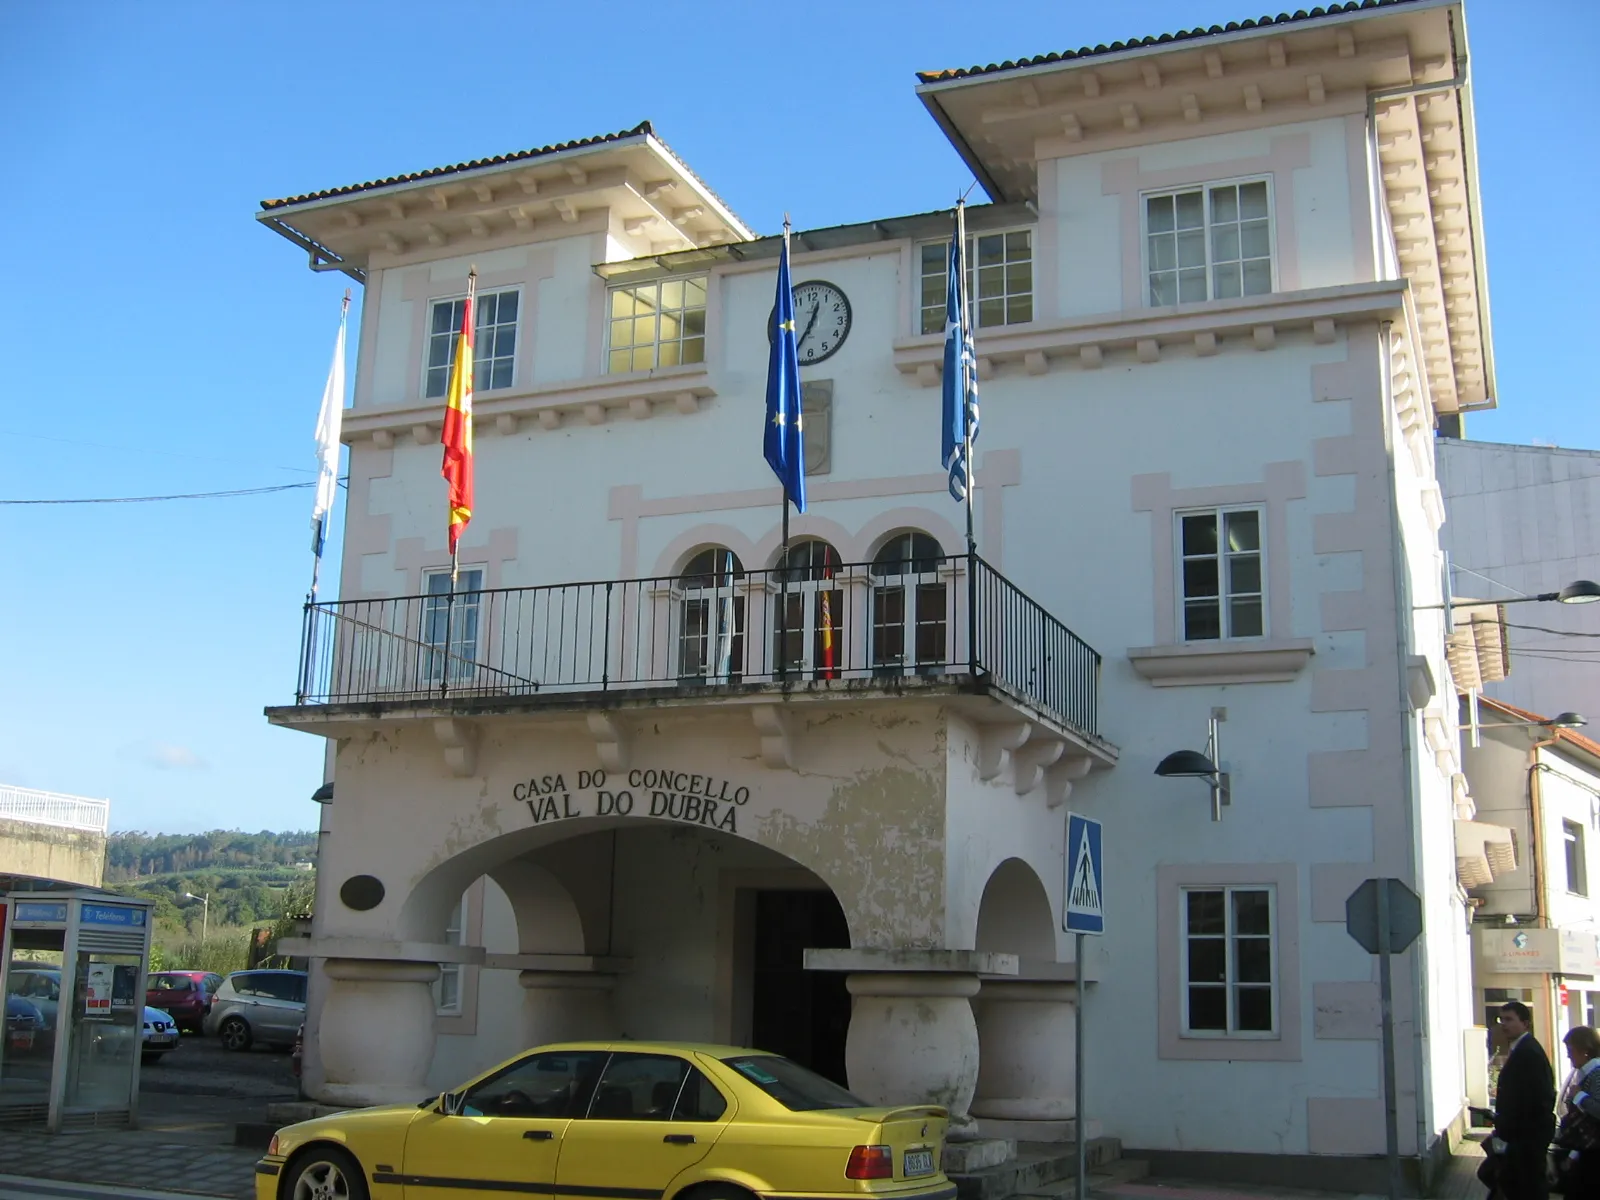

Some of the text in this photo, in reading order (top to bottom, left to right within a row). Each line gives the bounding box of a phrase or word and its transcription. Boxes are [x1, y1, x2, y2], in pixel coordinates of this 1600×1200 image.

[807, 292, 818, 301] 12
[824, 294, 829, 303] 1
[833, 303, 840, 312] 2
[837, 316, 844, 326] 3
[832, 329, 839, 338] 4
[821, 341, 828, 351] 5
[807, 348, 814, 357] 6
[513, 769, 750, 806] CASA DO CONCELLO
[526, 790, 738, 833] VAL DO DUBRA
